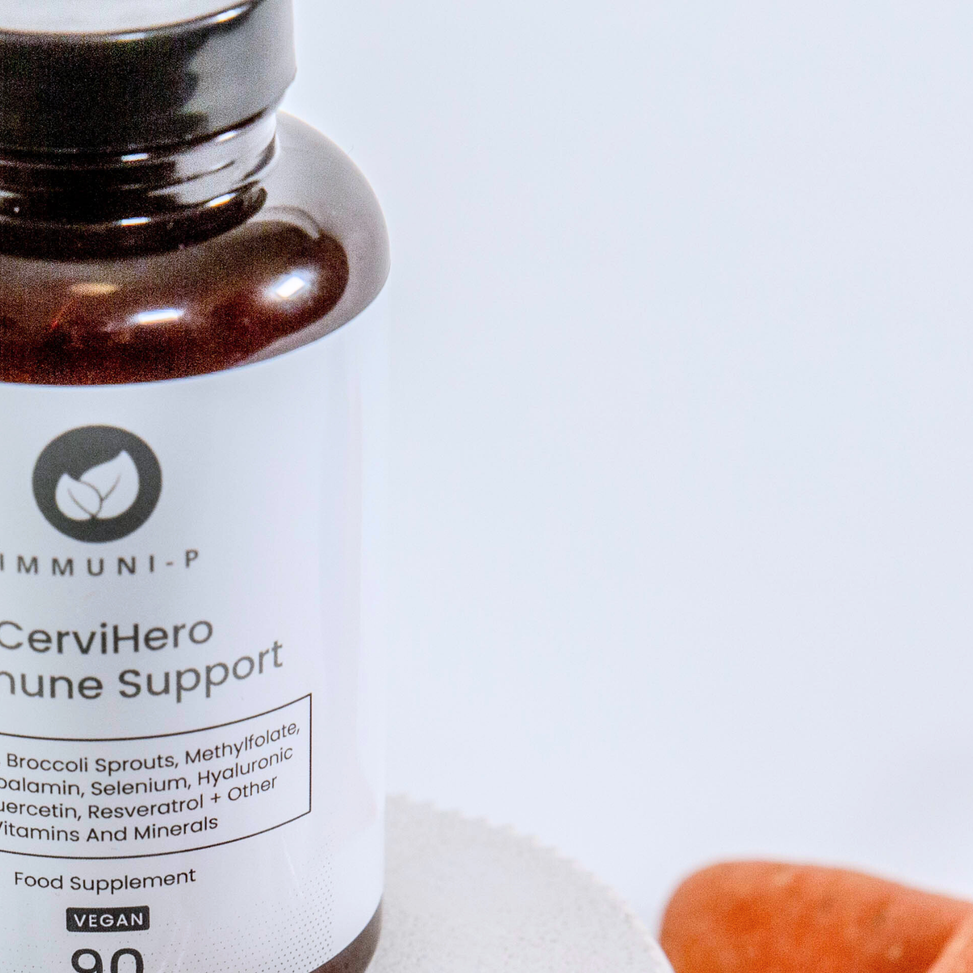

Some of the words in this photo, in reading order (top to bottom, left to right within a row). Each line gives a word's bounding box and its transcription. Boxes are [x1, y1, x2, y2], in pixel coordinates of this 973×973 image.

[0, 550, 199, 577] IMMUNI-P
[118, 640, 283, 704] Support
[7, 753, 88, 772] Broccoli
[95, 753, 179, 777] Sprouts,
[186, 722, 300, 765] Methylfolate,
[91, 774, 191, 796] Selenium,
[197, 747, 293, 786] Hyaluronic
[88, 795, 203, 819] Resveratrol
[210, 792, 221, 804] +
[228, 774, 278, 801] Other
[86, 827, 127, 843] And
[134, 816, 218, 840] Minerals
[14, 871, 63, 890] Food
[70, 868, 196, 894] Supplement
[74, 912, 144, 927] VEGAN
